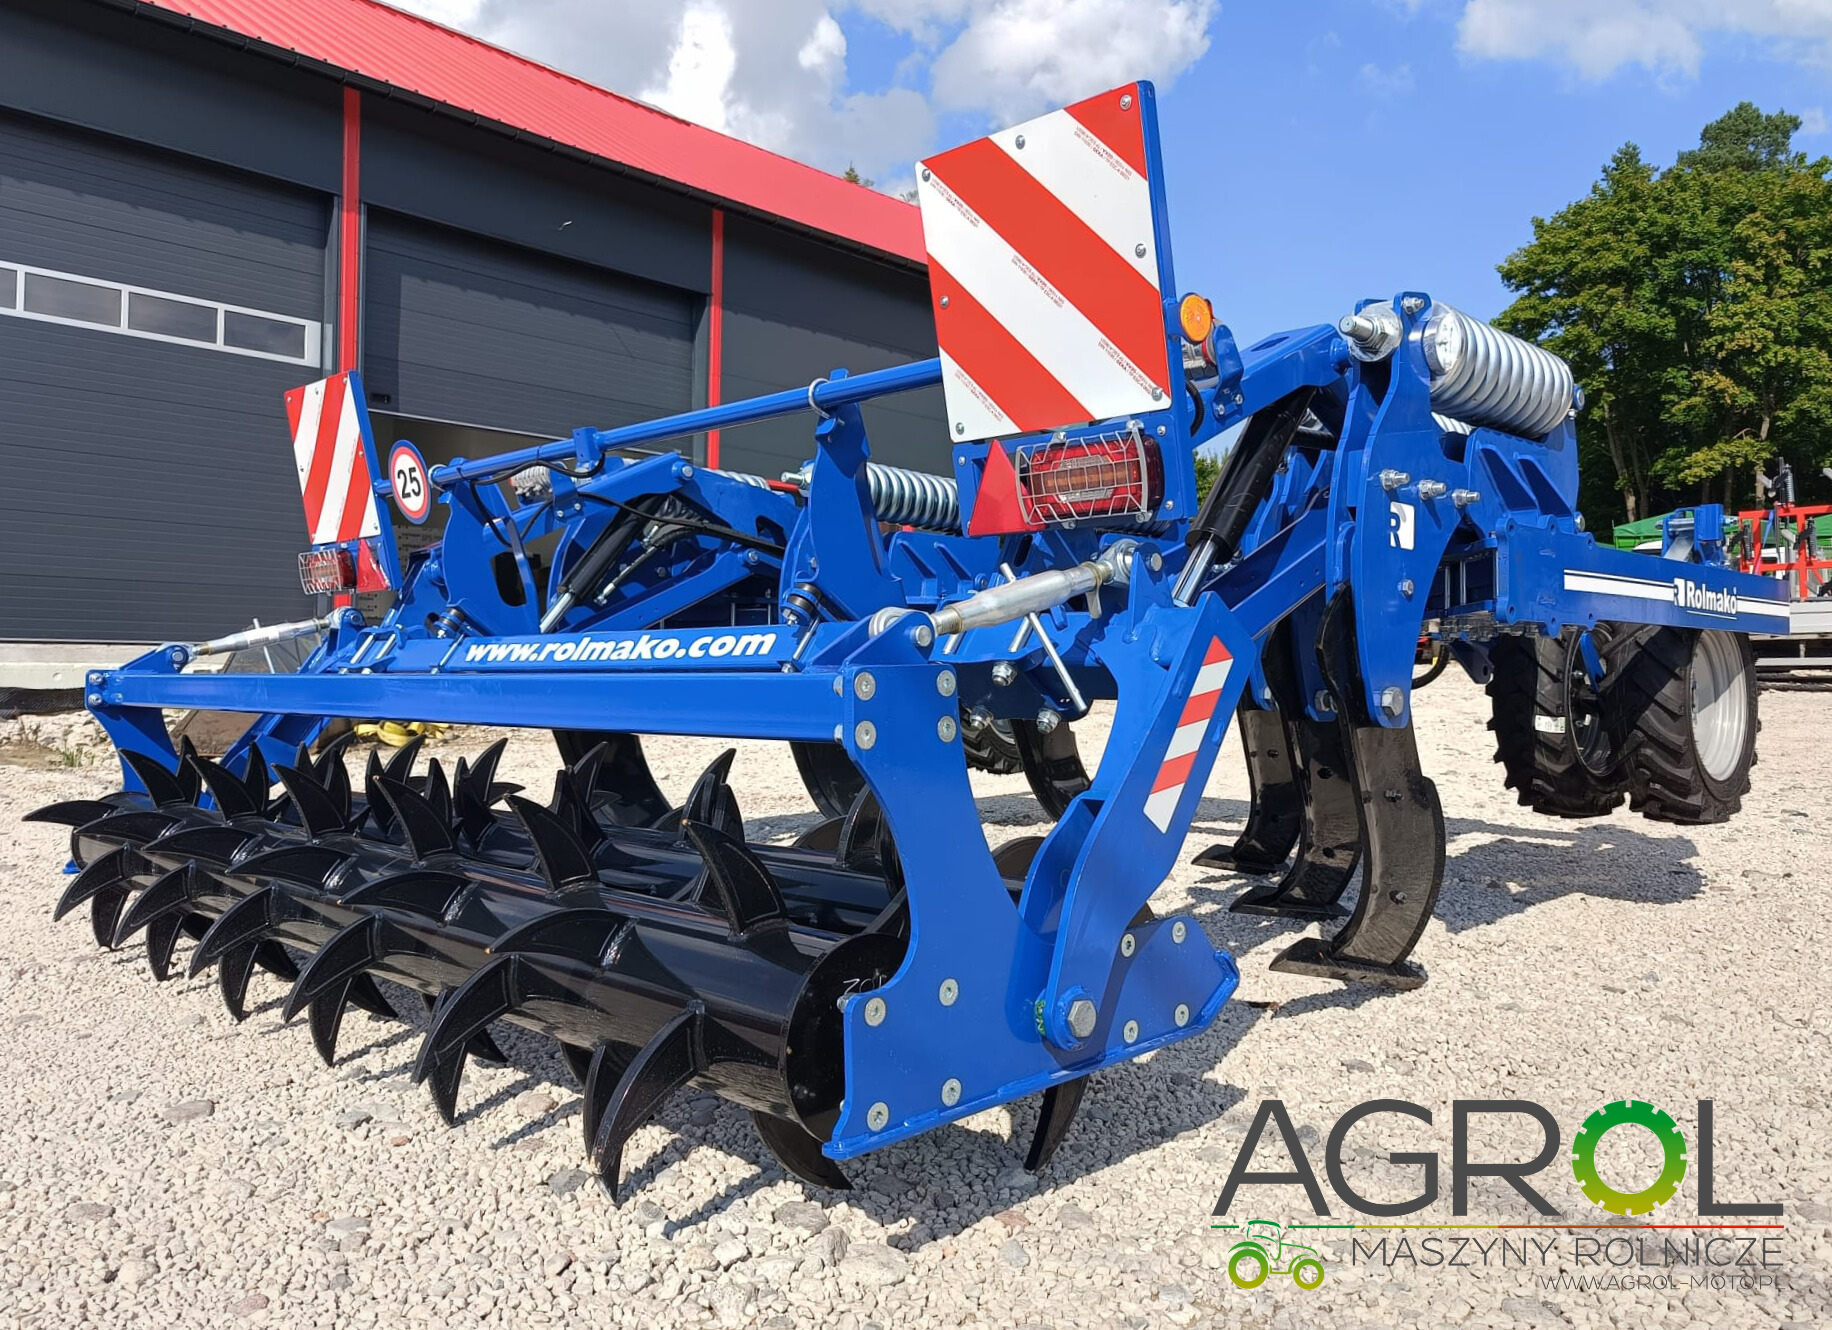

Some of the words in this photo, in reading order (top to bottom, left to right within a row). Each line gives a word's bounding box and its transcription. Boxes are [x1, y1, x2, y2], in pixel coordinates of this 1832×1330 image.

[397, 466, 422, 499] 25
[1686, 580, 1738, 615] Rolmako
[465, 633, 777, 662] www.rolmako.com
